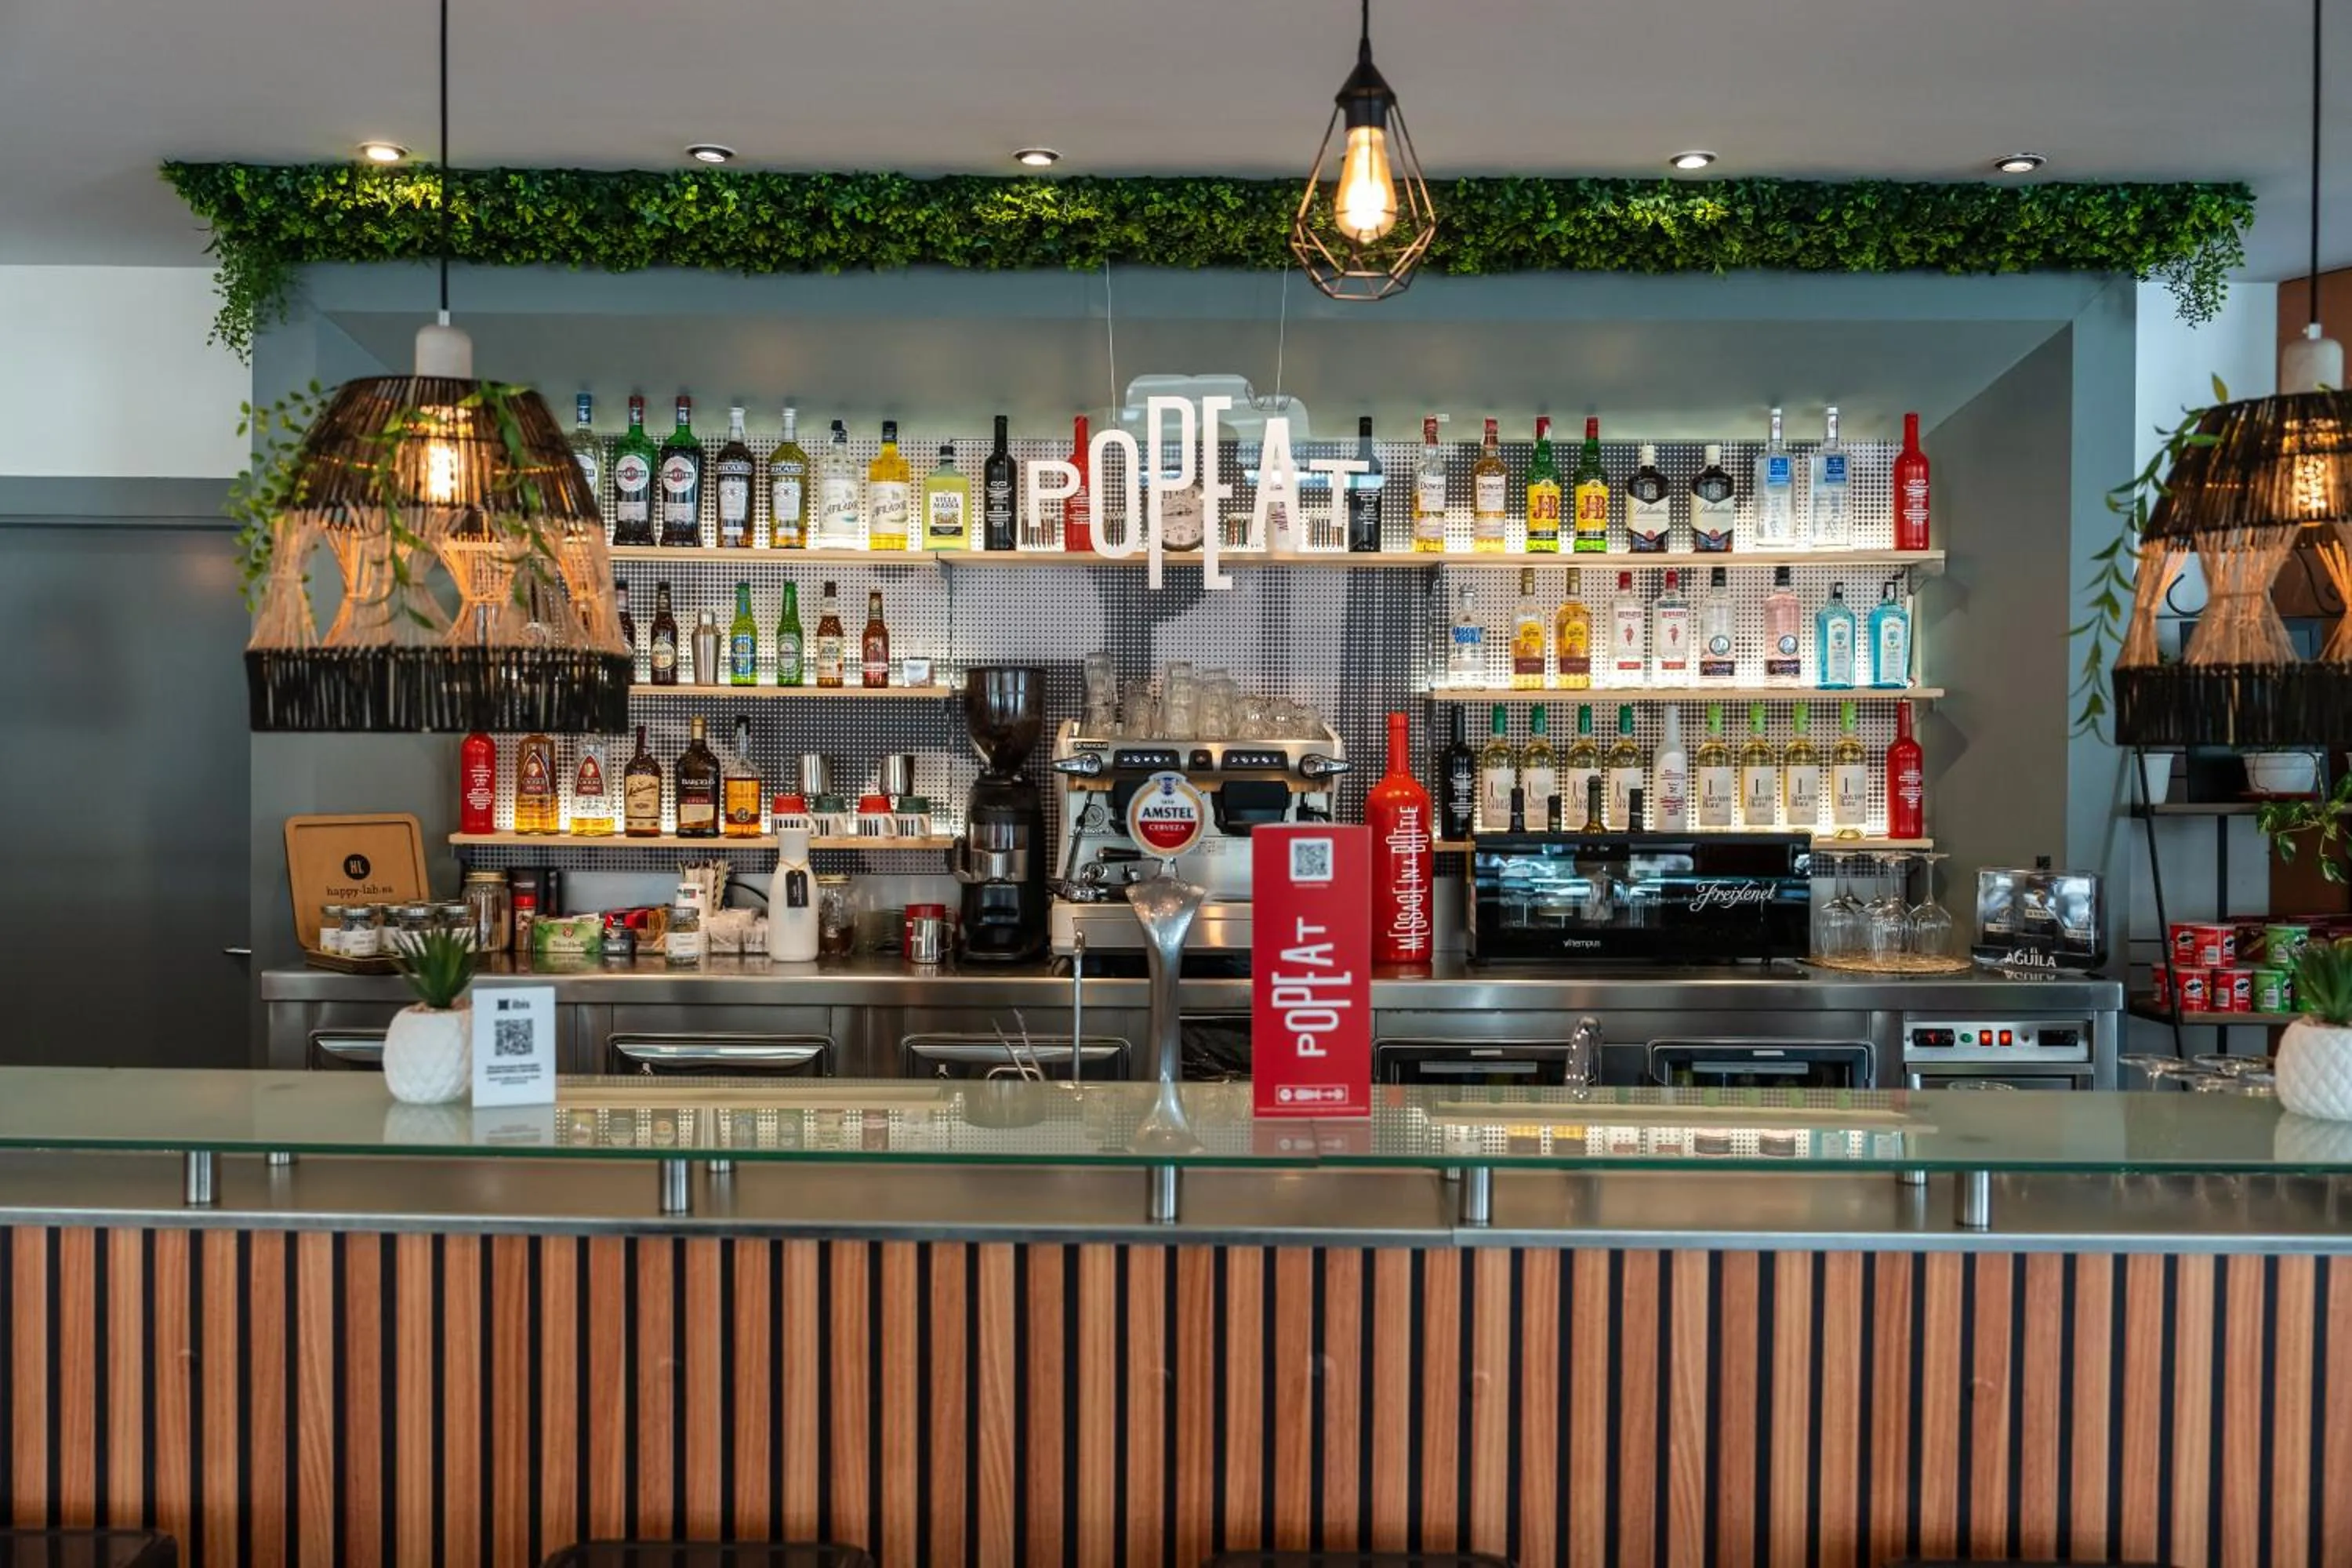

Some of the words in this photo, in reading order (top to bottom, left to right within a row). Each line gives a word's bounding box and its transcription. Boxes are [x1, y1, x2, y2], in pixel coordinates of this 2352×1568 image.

[1026, 395, 1370, 590] POPEAT
[1142, 807, 1193, 819] AMSTEL
[1385, 805, 1429, 854] BOTTLE
[1387, 886, 1431, 951] MESSAGE
[1689, 880, 1777, 912] Freixenet
[1271, 916, 1352, 1057] POPEAT
